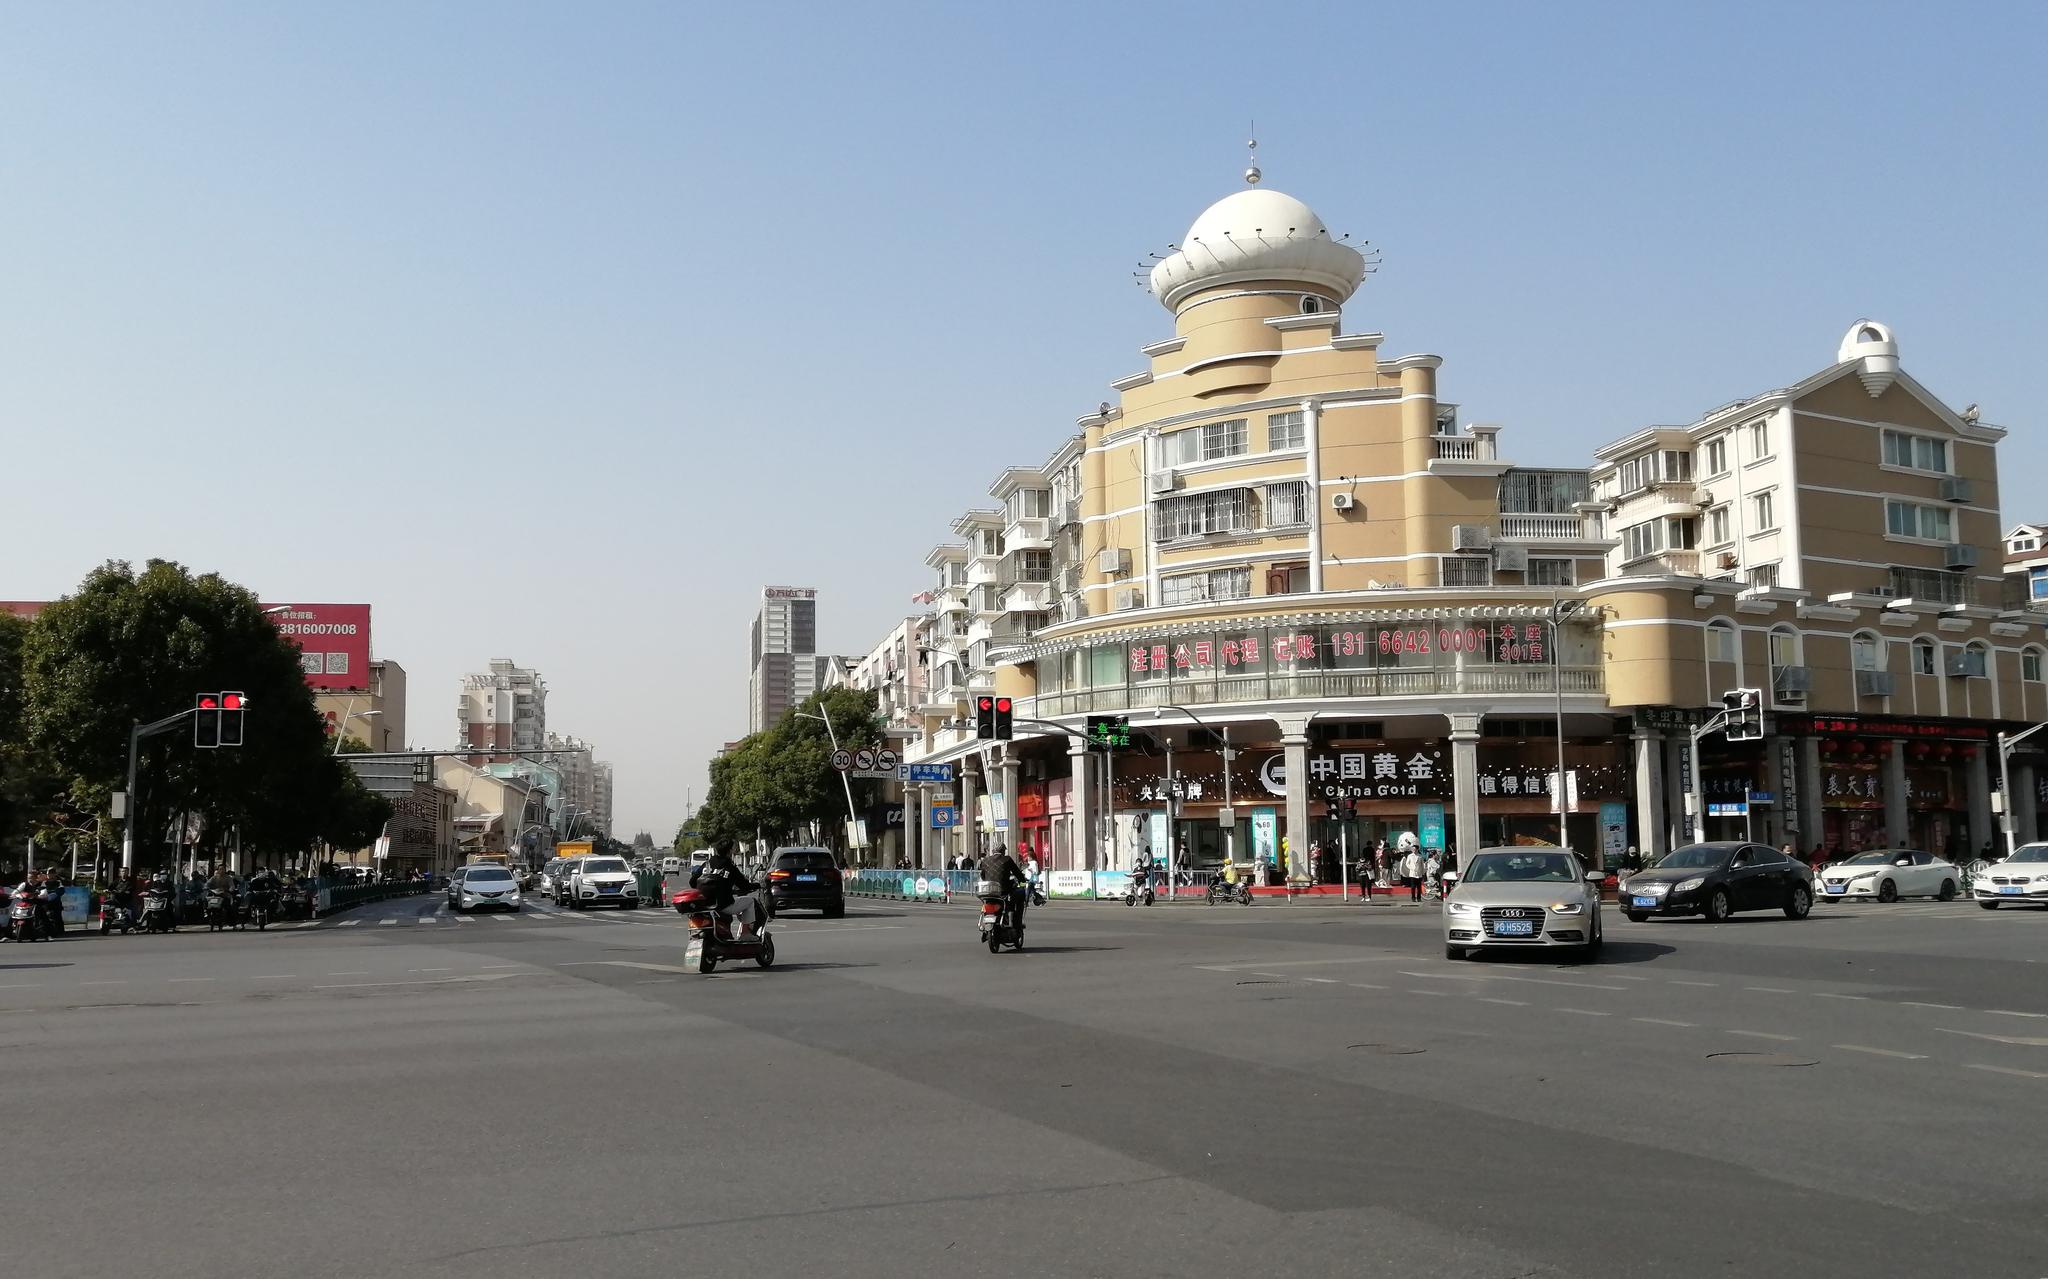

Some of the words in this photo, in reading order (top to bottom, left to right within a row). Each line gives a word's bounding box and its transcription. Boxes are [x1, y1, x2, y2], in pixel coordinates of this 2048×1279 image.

[275, 624, 356, 635] 3816007008
[1331, 631, 1364, 656] 131
[1378, 629, 1430, 655] 6642
[1439, 628, 1486, 653] 0001
[1500, 643, 1543, 661] 301室
[835, 755, 849, 766] 30
[1309, 752, 1434, 781] 中国黄金
[899, 766, 909, 779] P
[912, 765, 941, 774] 停车场
[1325, 785, 1372, 797] China
[1377, 784, 1418, 797] Gold
